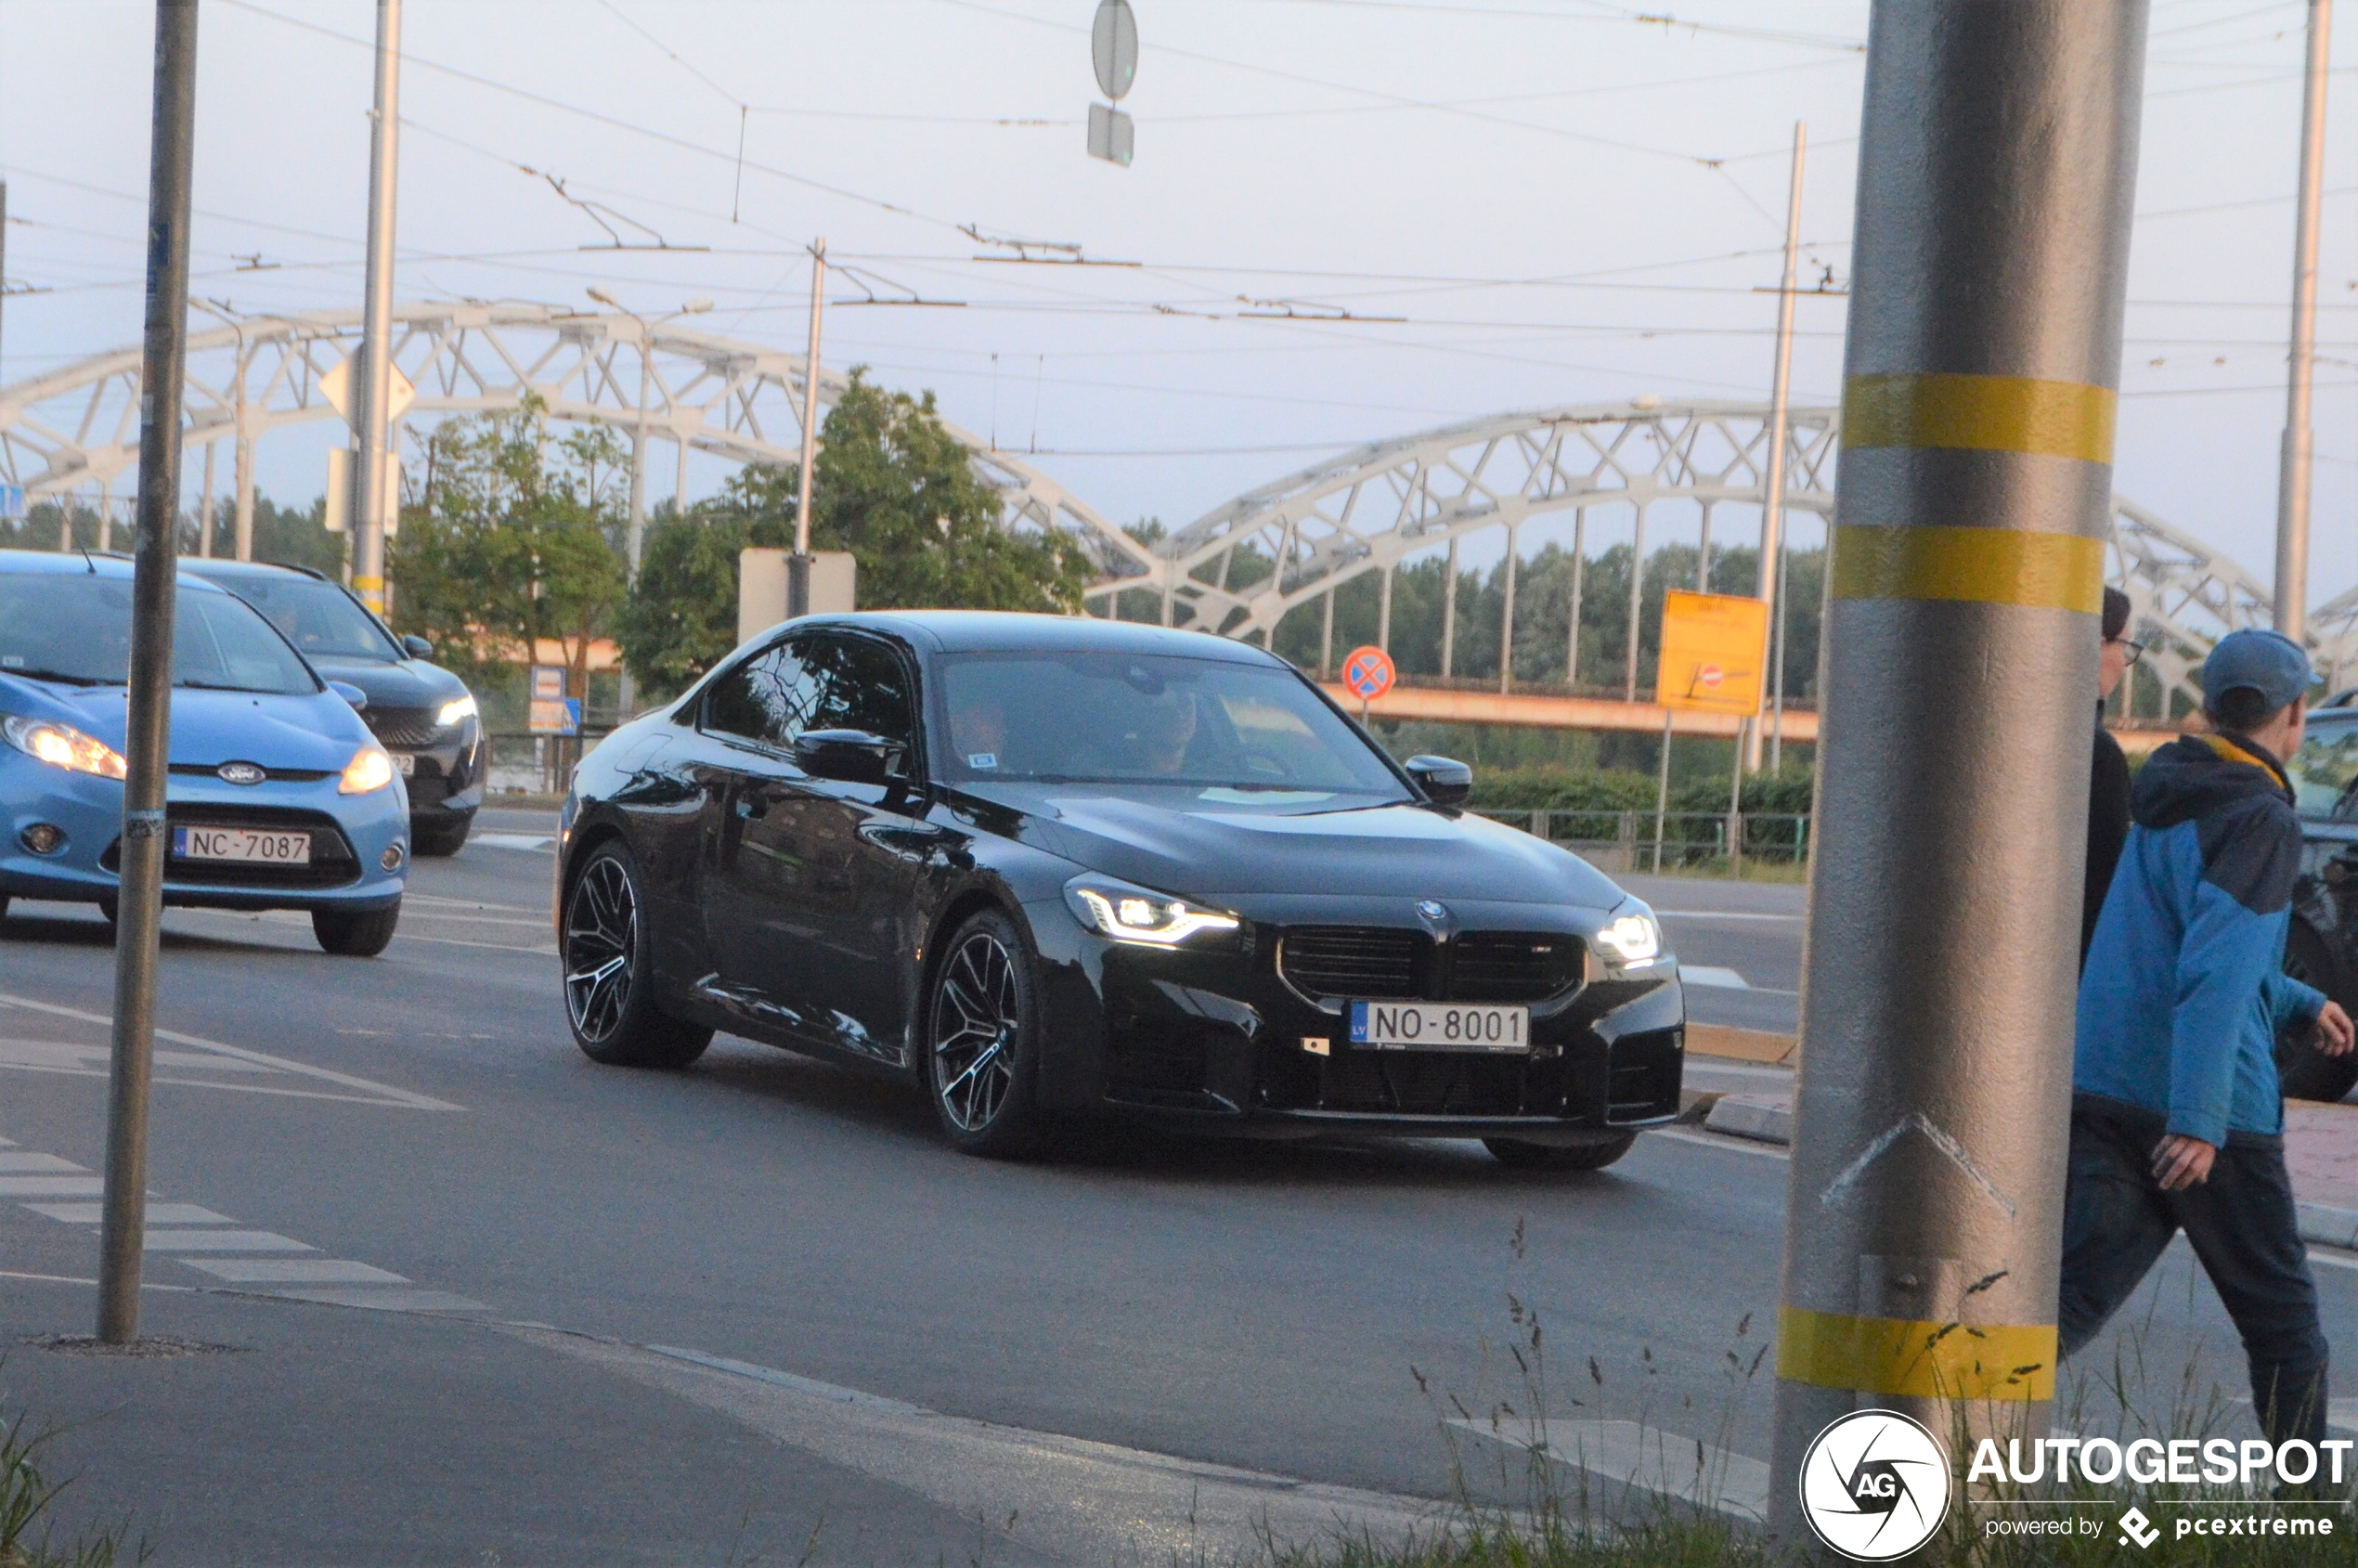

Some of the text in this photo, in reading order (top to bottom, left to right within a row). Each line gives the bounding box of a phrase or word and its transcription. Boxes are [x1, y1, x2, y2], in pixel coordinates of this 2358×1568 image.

[193, 832, 305, 859] NC-7087
[1352, 1007, 1519, 1042] LV NO-8001
